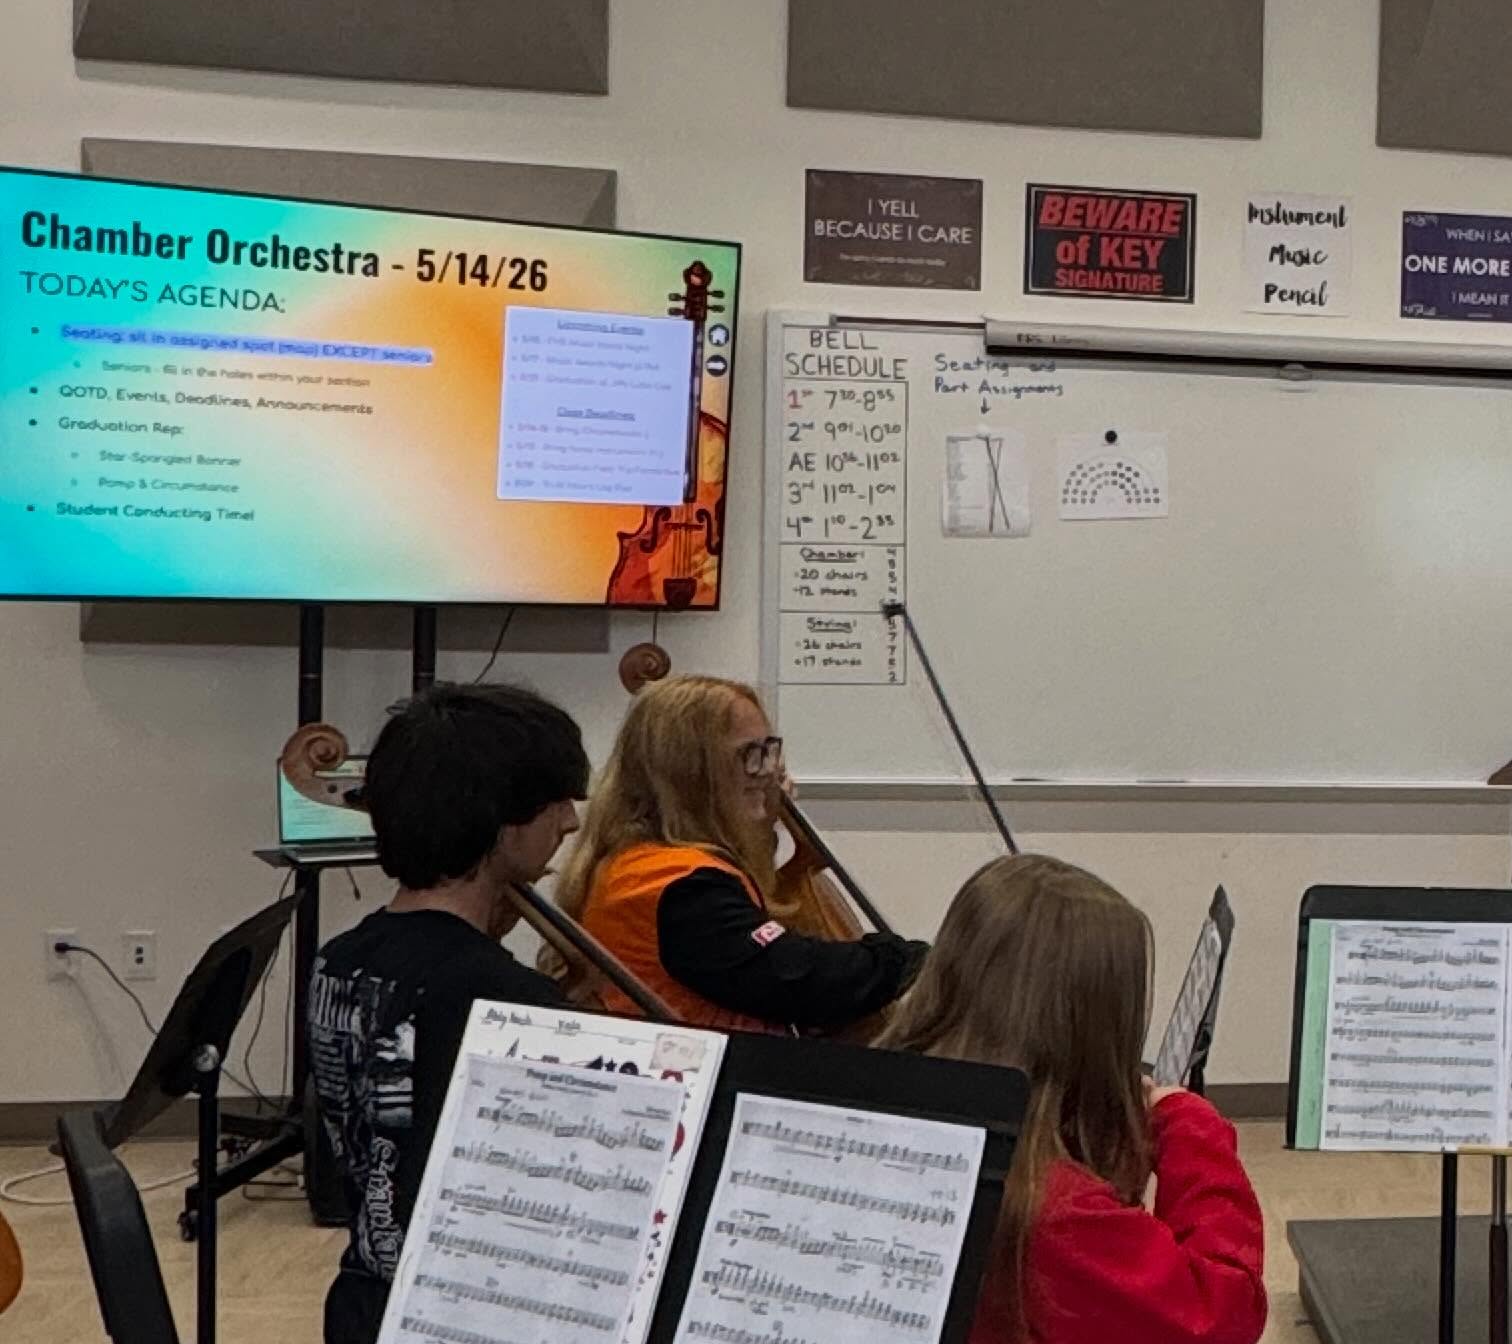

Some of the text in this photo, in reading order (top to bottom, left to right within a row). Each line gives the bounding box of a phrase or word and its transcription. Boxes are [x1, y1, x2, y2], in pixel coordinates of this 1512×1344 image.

[867, 198, 920, 218] I YELL
[1040, 194, 1185, 236] BEWARE
[814, 219, 974, 244] BECAUSE I CARE
[1446, 228, 1485, 243] WHEN
[22, 211, 193, 261] Chamber
[206, 228, 380, 278] Orchestra
[416, 248, 548, 292] 5/14/26
[1056, 234, 1165, 271] of KEY
[1268, 243, 1329, 268] Music
[1405, 255, 1448, 274] ONE
[1452, 257, 1510, 277] MORE
[19, 270, 286, 313] TODAY'S AGENDA:
[1056, 268, 1164, 293] SIGNATURE
[1264, 280, 1328, 307] Pencil
[1459, 291, 1498, 305] MEAN
[1501, 294, 1511, 306] IT
[323, 344, 377, 357] EXCEPT
[810, 329, 879, 350] BELL
[785, 352, 908, 380] SCHEDULE
[935, 352, 1056, 377] Seating and
[60, 385, 374, 415] QOTD, Events, Deadlines, Announcements
[935, 376, 1064, 400] Part Assignments
[59, 416, 148, 432] Graduation
[197, 455, 242, 467] Banner
[788, 452, 816, 471] AE
[99, 477, 240, 494] Pomp & Circumstance
[56, 502, 119, 516] Student
[123, 505, 212, 522] Conducting
